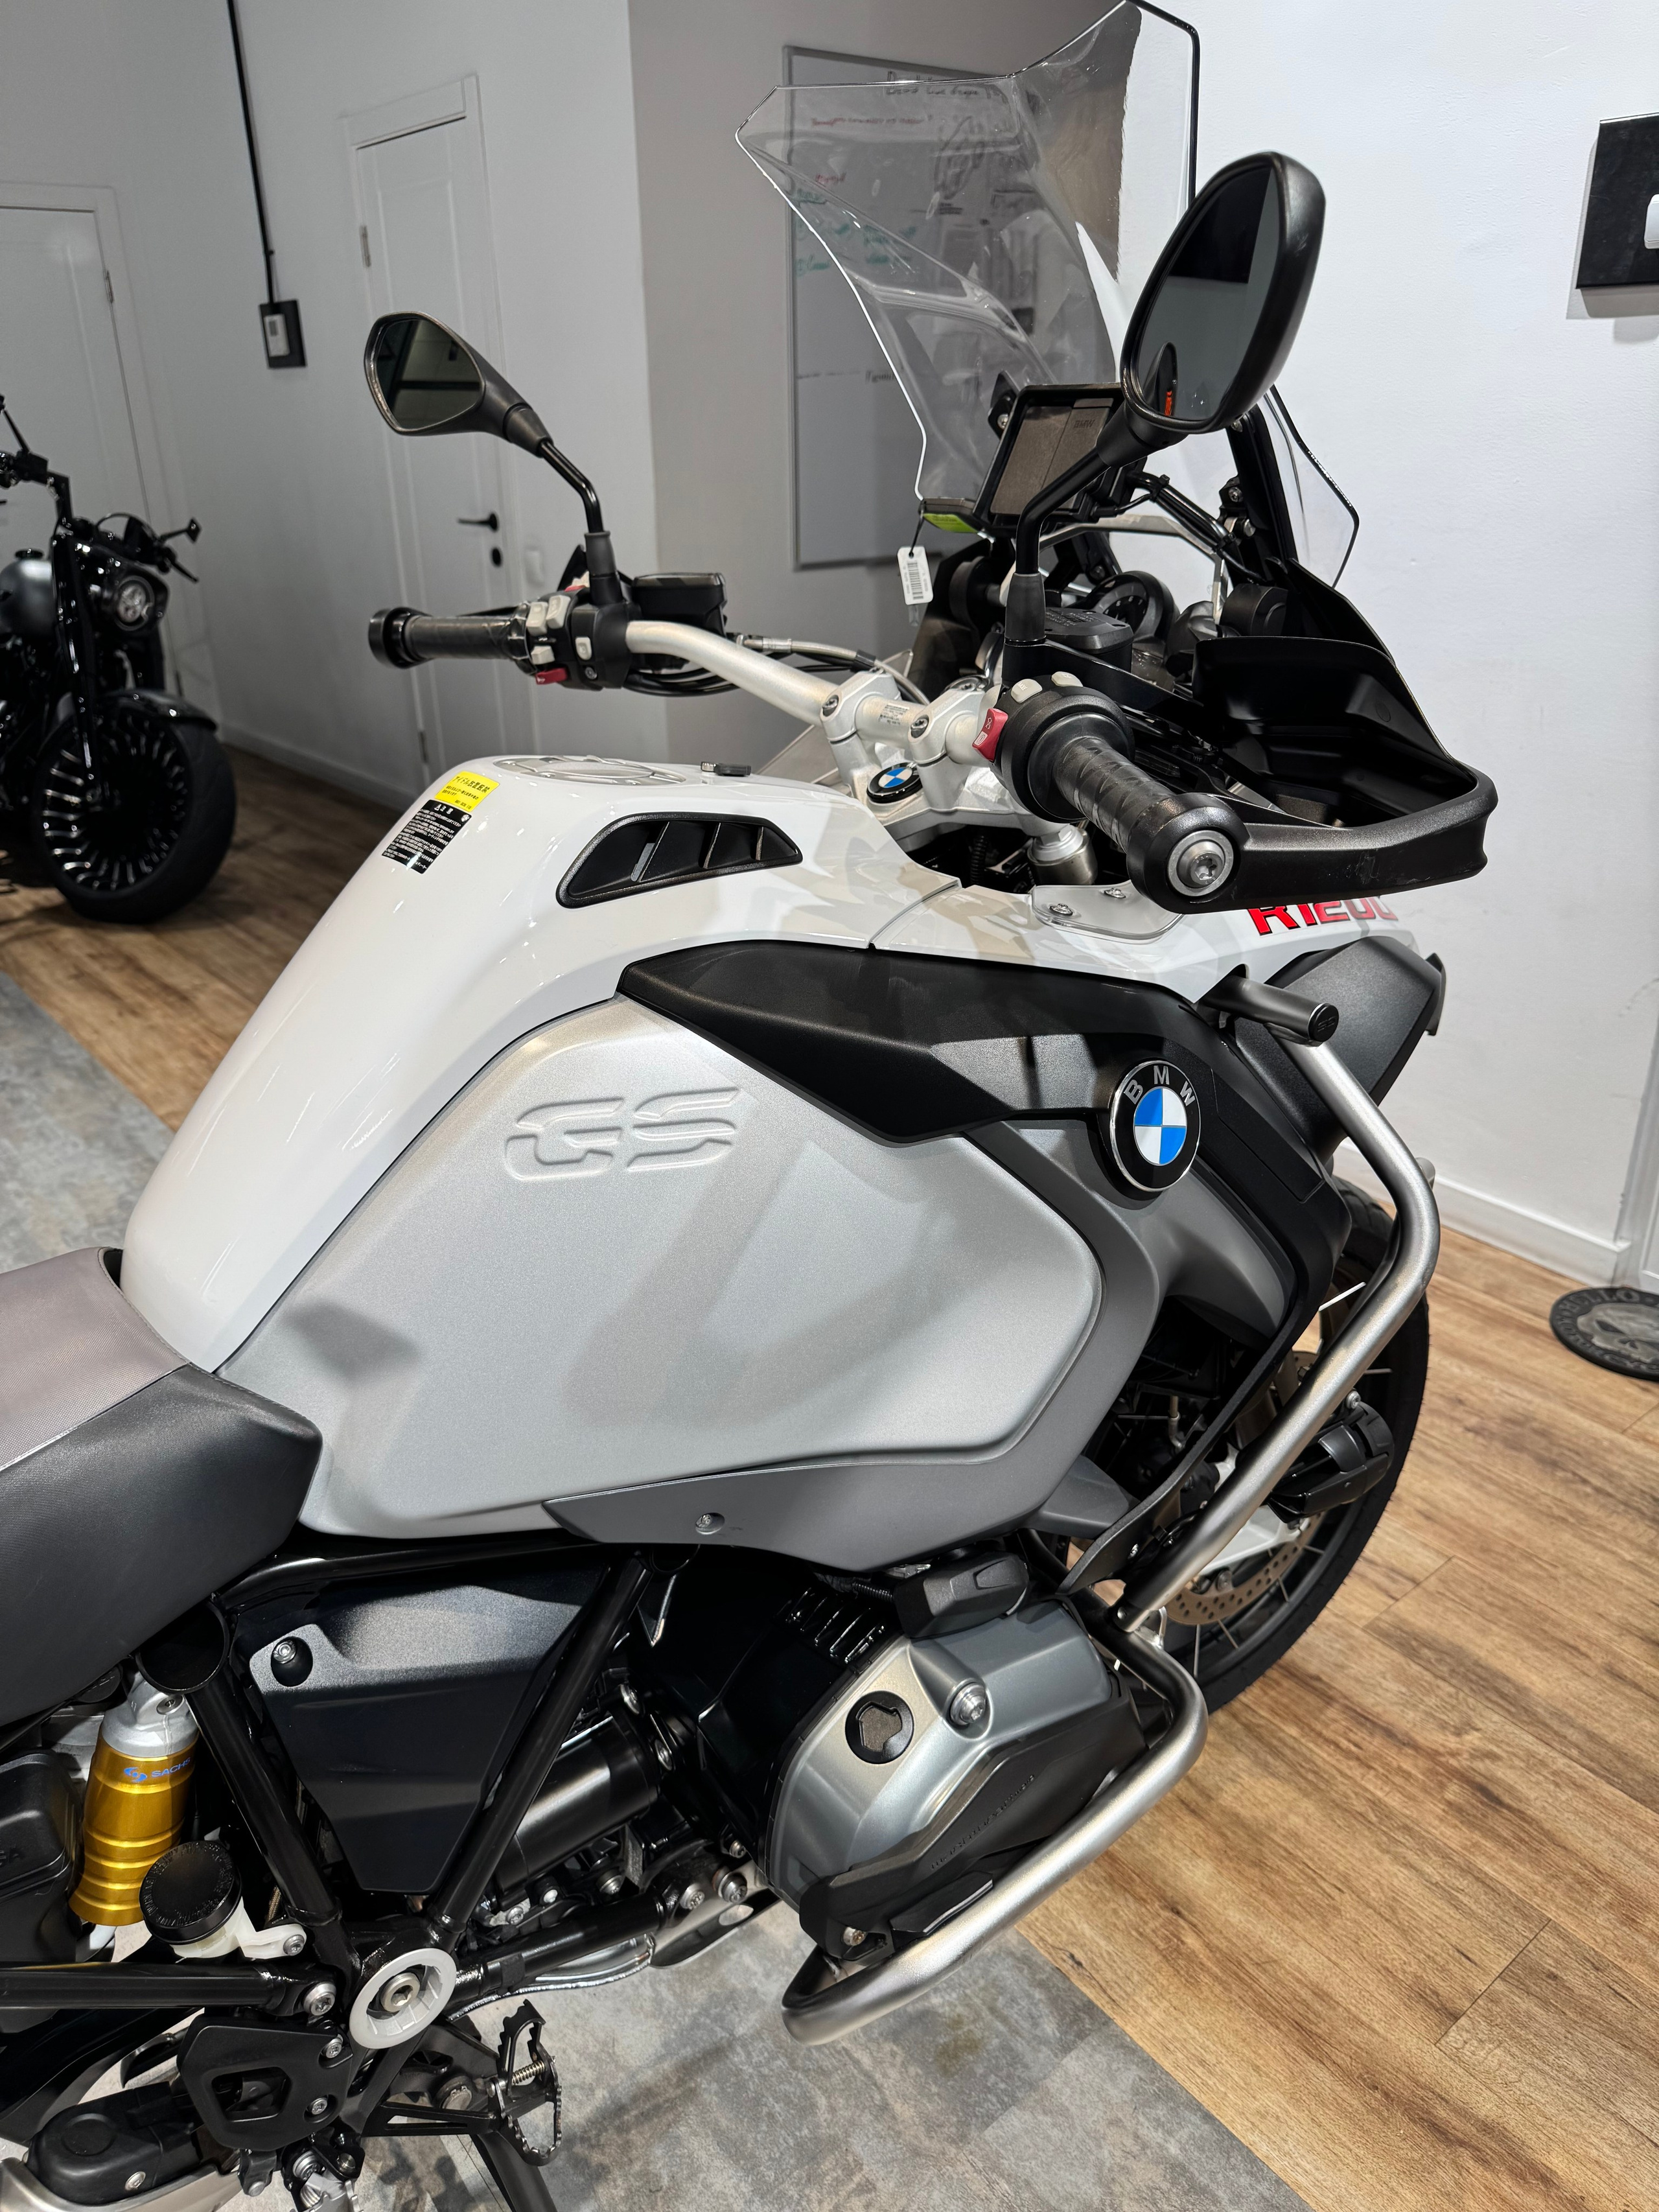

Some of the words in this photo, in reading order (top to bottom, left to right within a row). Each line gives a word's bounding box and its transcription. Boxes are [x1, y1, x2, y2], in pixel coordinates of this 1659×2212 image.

[1073, 419, 1095, 429] BMW
[1124, 1065, 1196, 1107] BMW
[504, 1086, 739, 1182] GS
[151, 1757, 191, 1778] SACHS
